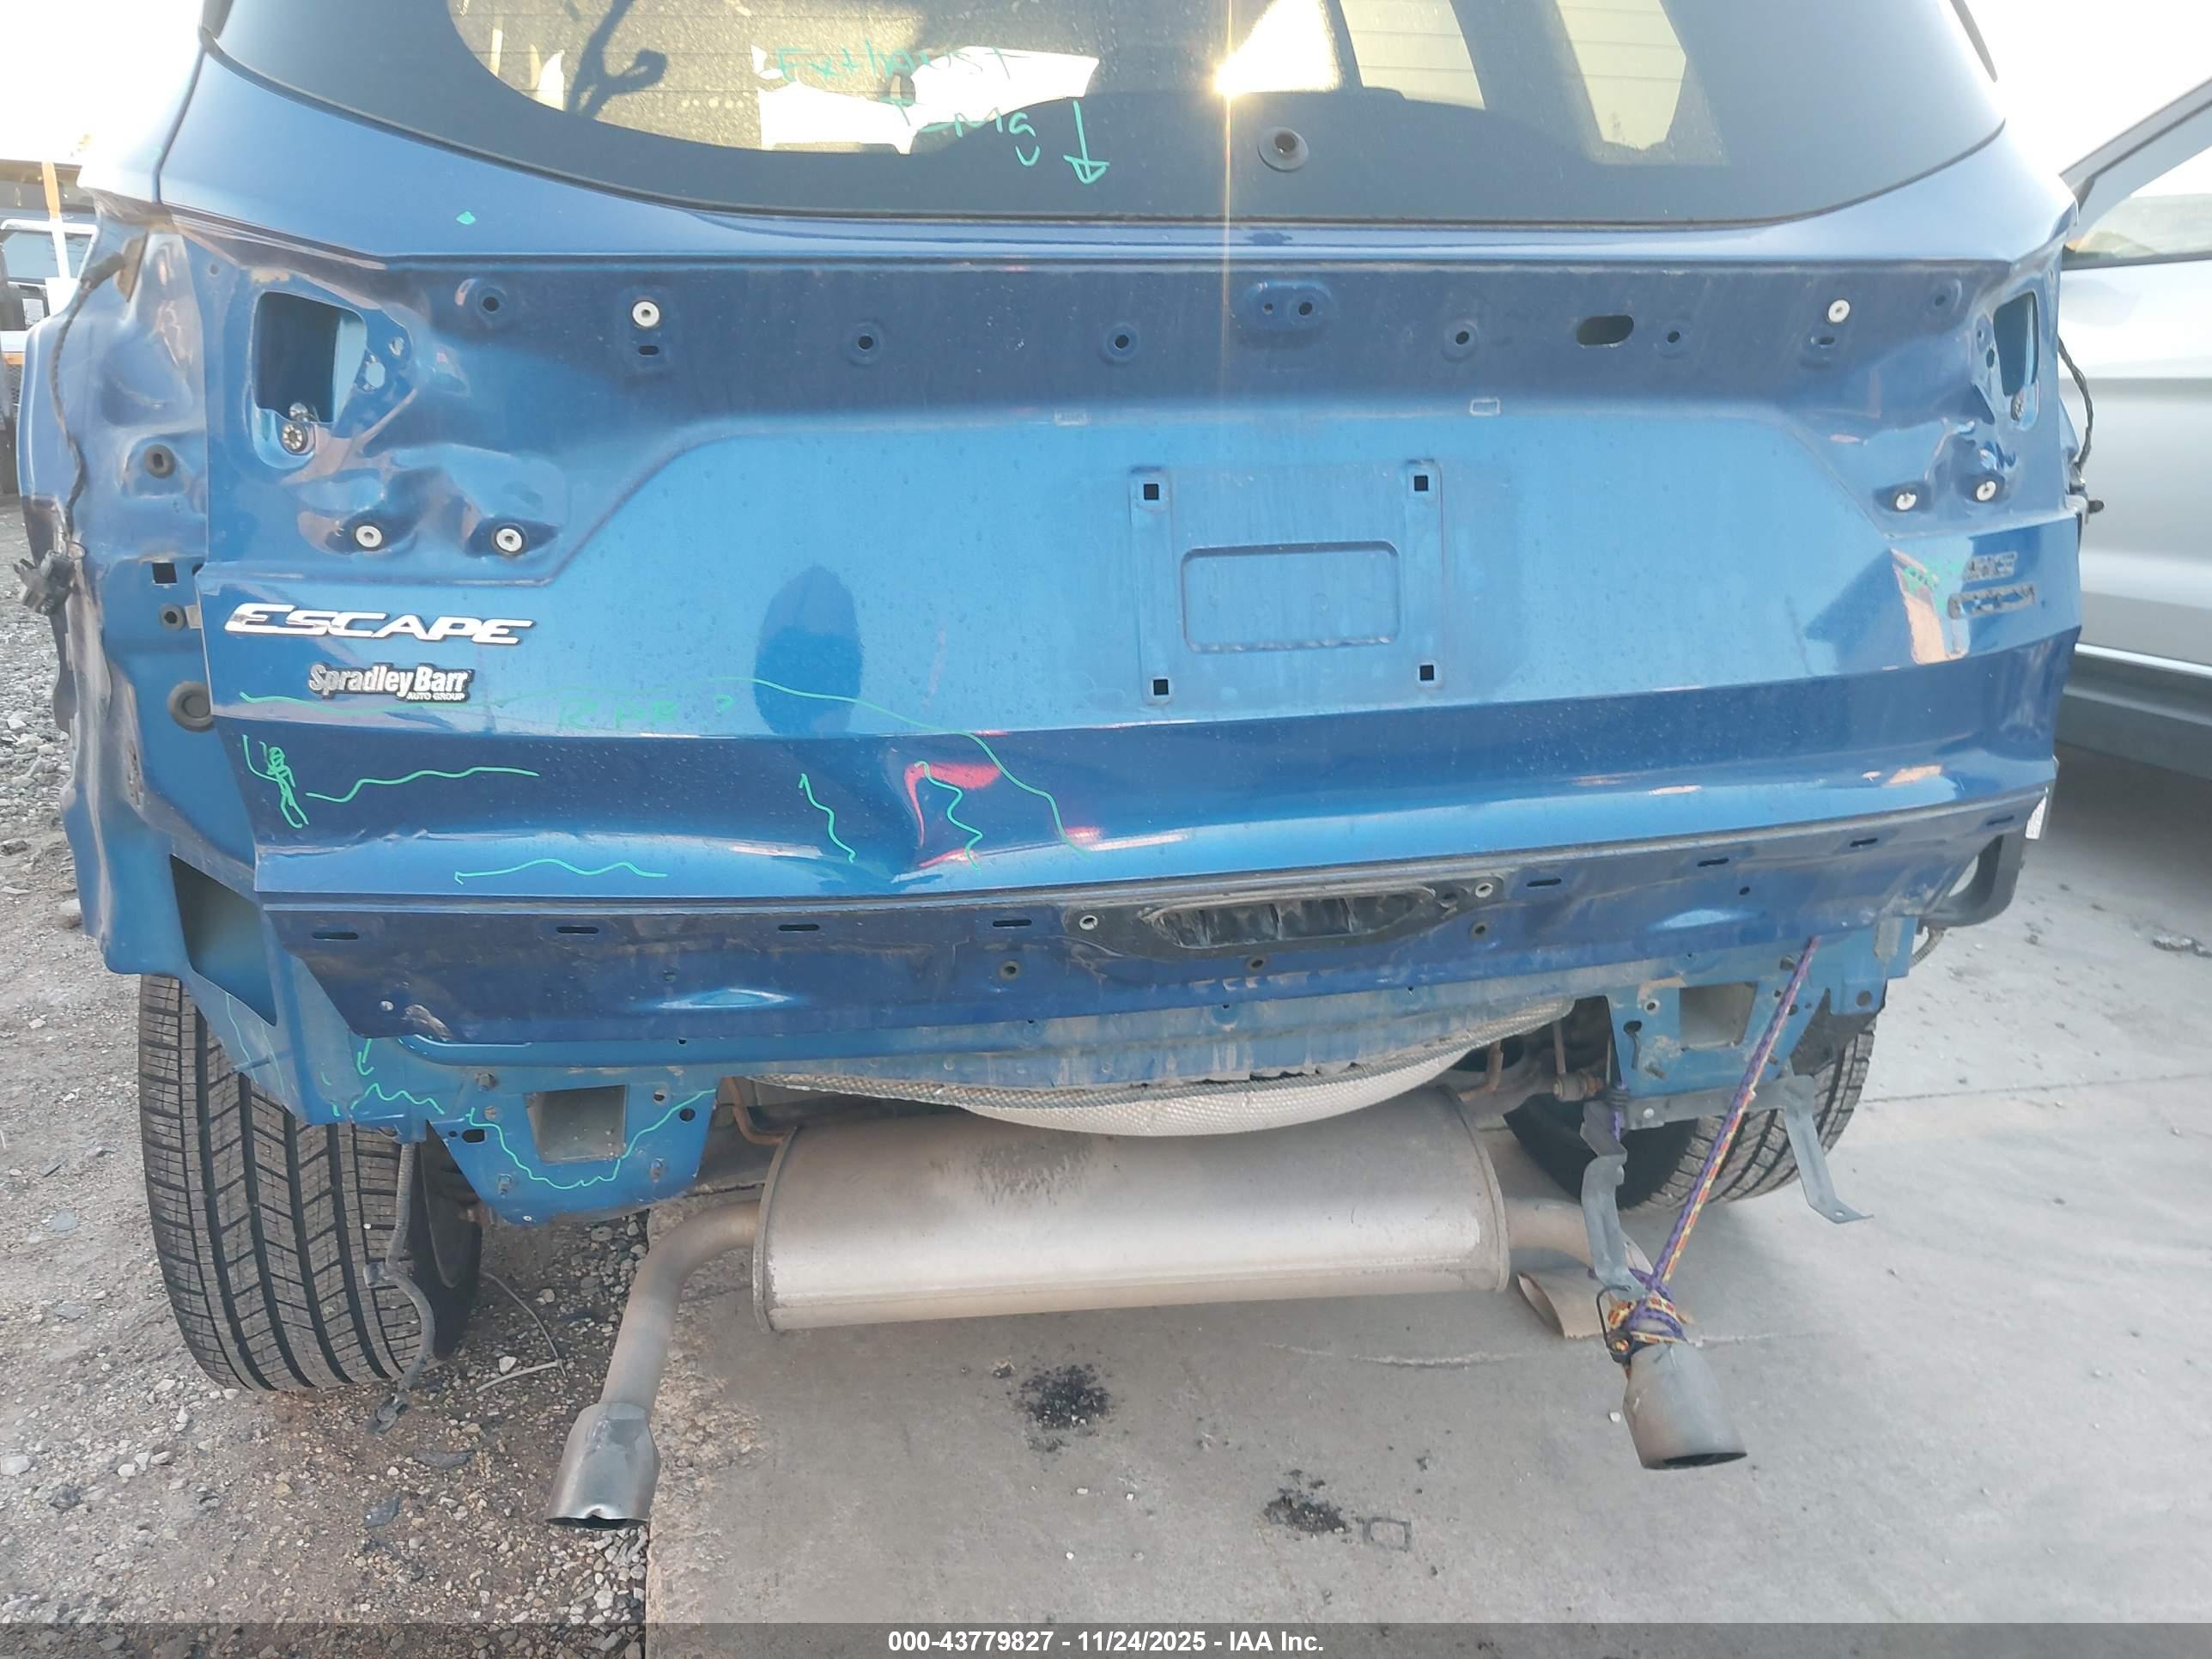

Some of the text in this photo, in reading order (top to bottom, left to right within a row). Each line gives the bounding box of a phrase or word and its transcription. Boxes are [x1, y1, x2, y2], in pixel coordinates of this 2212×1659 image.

[225, 603, 535, 644] ESCAPE
[309, 664, 469, 697] Spradley Barr
[406, 692, 465, 701] AUTO GROUP
